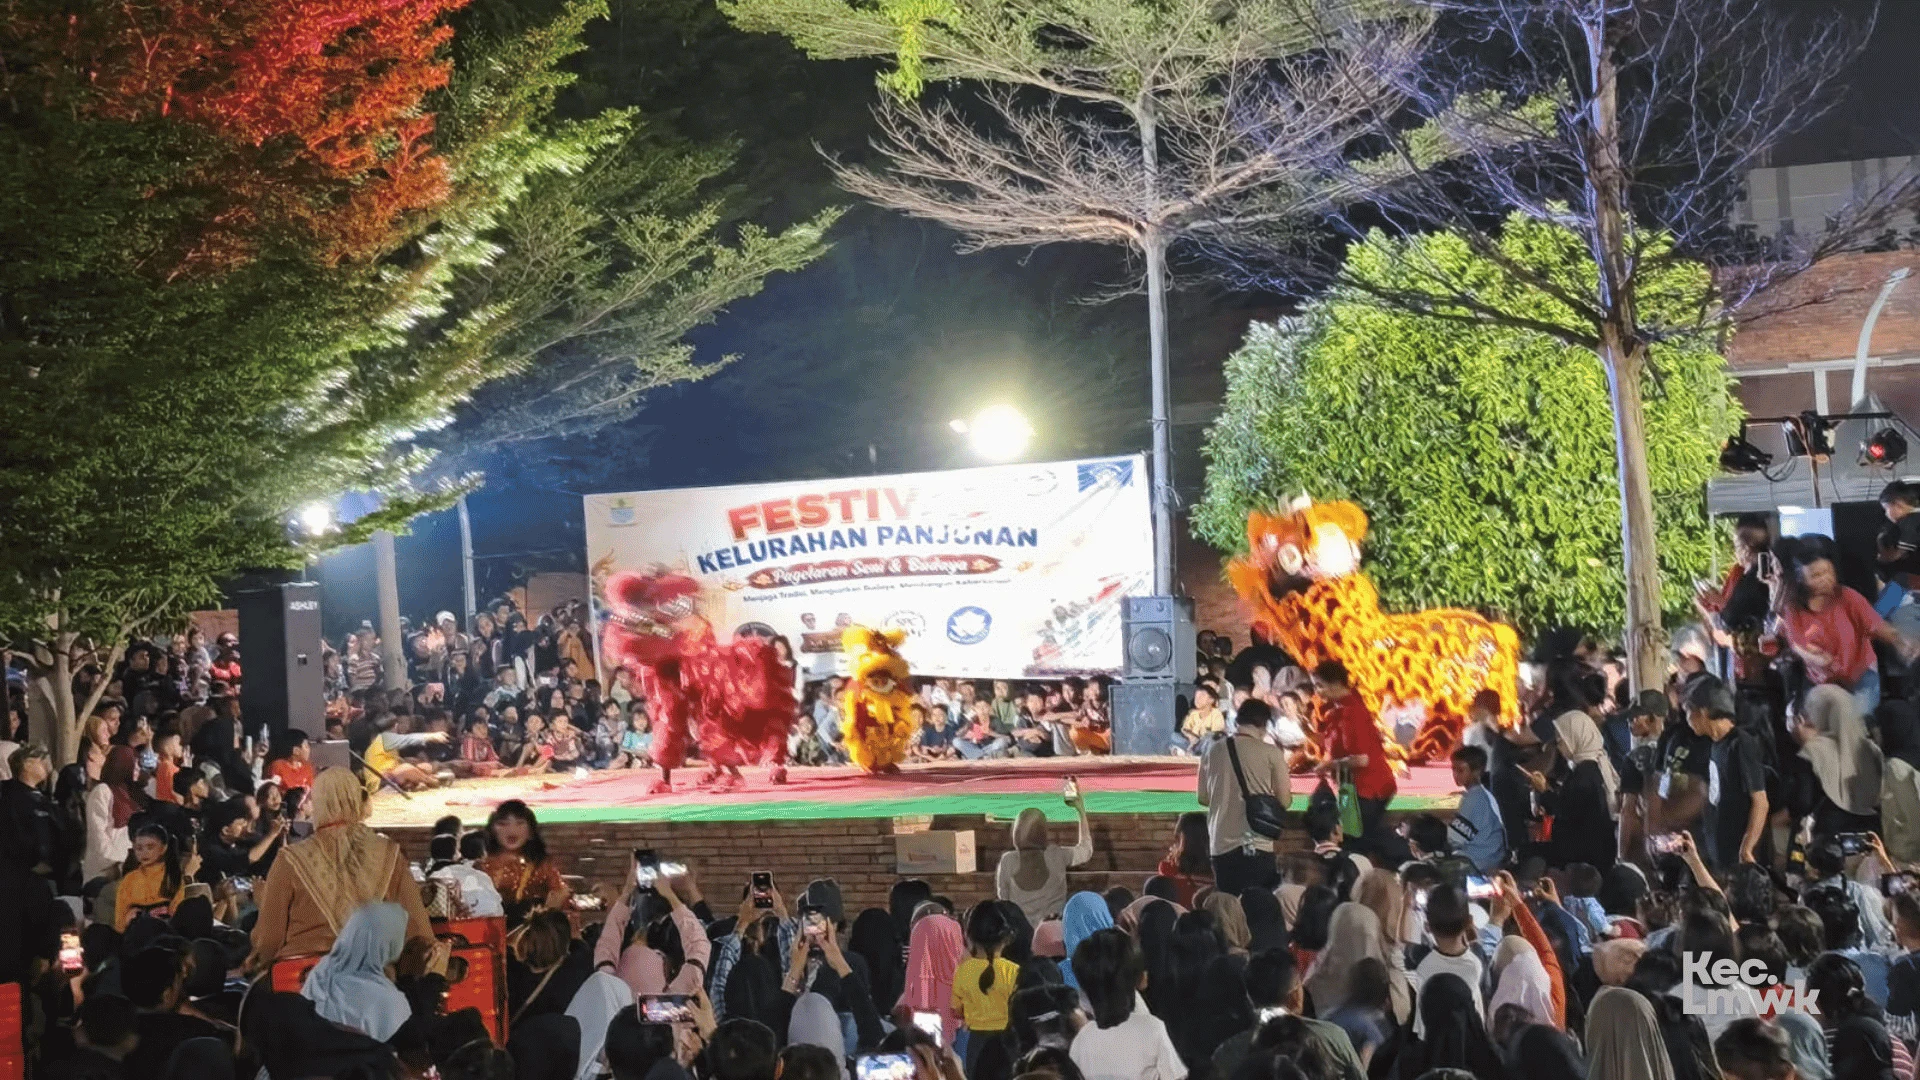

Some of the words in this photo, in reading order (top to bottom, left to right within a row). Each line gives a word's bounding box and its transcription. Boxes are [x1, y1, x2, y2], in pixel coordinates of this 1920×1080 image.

[727, 488, 920, 542] FESTIV
[697, 527, 867, 574] KELURAHAN
[877, 525, 1038, 547] PANJUNAN
